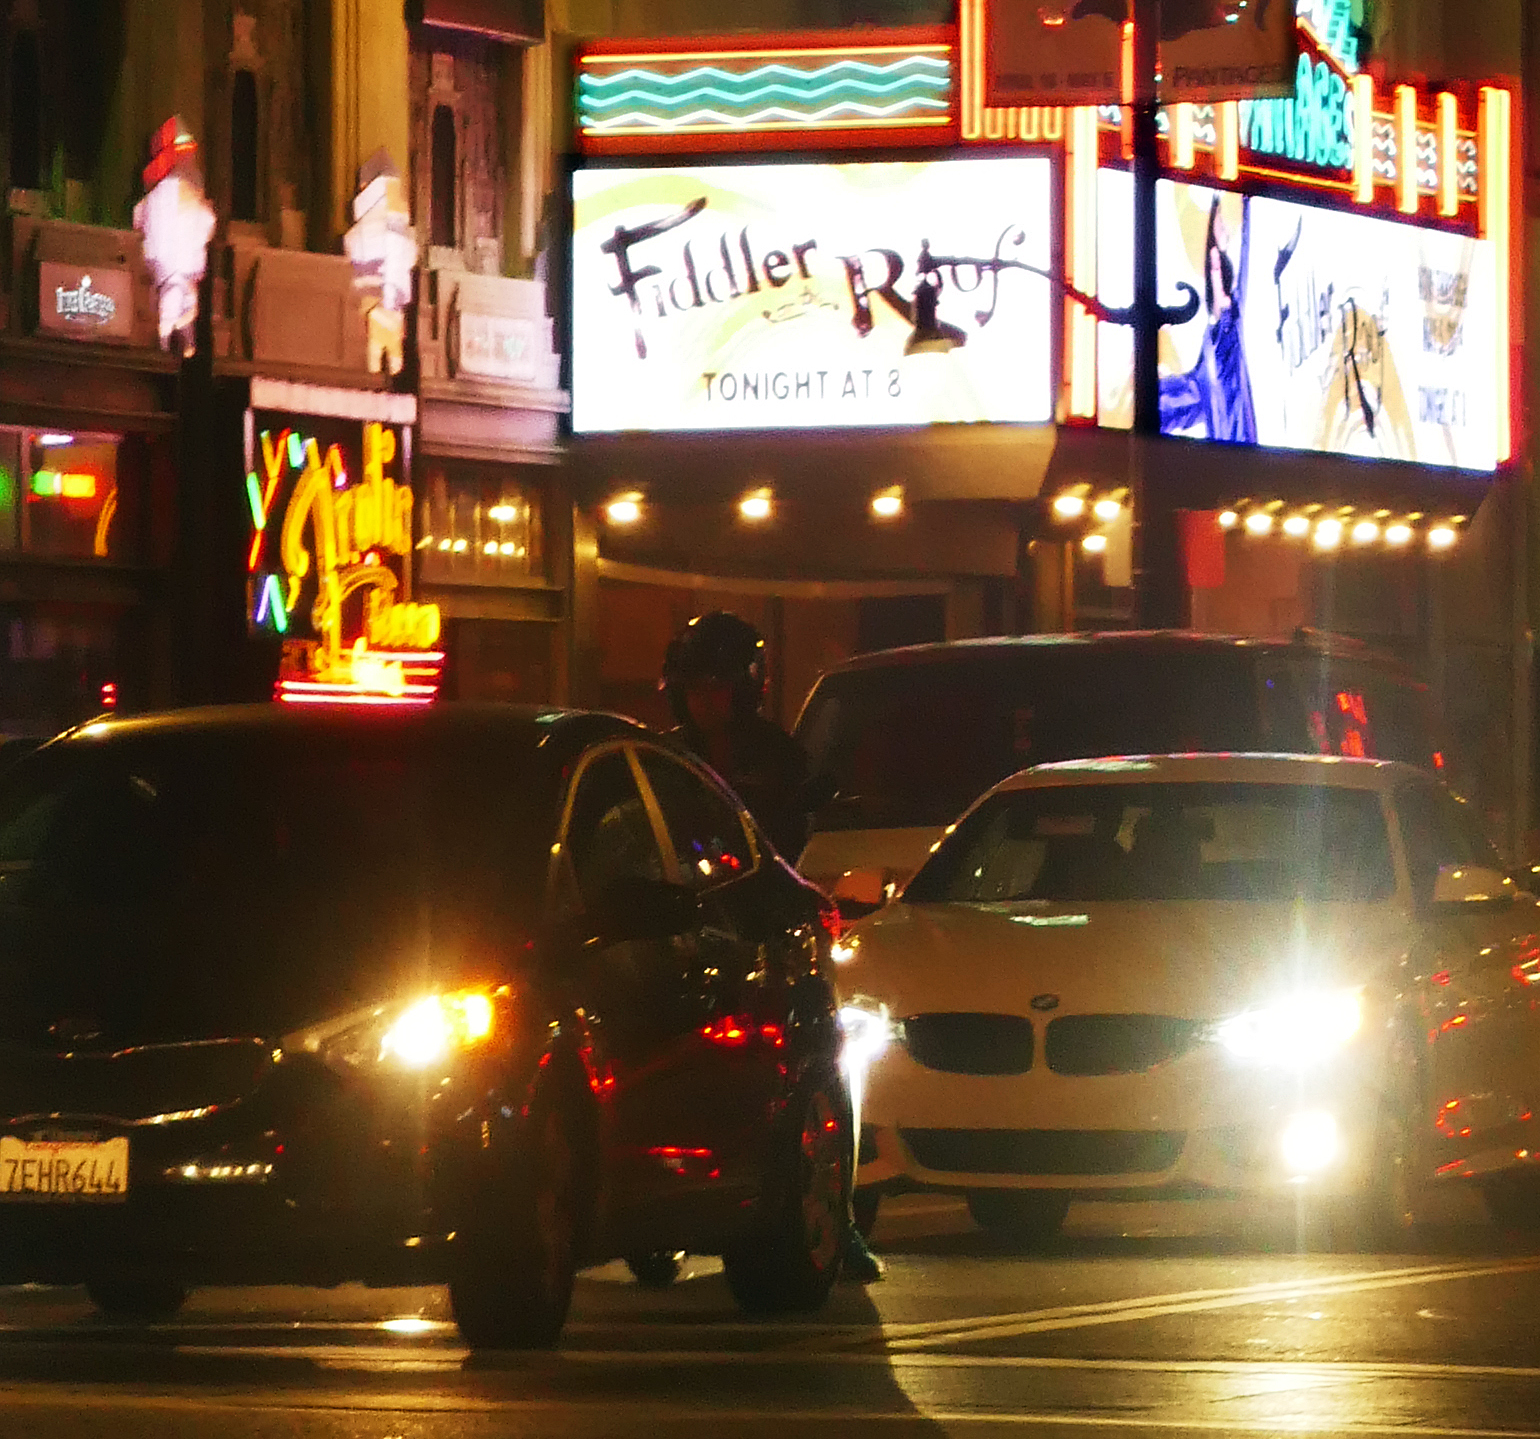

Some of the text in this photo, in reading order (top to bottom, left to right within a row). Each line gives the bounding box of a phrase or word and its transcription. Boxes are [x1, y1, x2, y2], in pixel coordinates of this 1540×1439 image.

[600, 196, 818, 359] Fiddler
[702, 368, 903, 402] TONIGHT AT 8
[4, 1158, 121, 1193] 7EHR644
